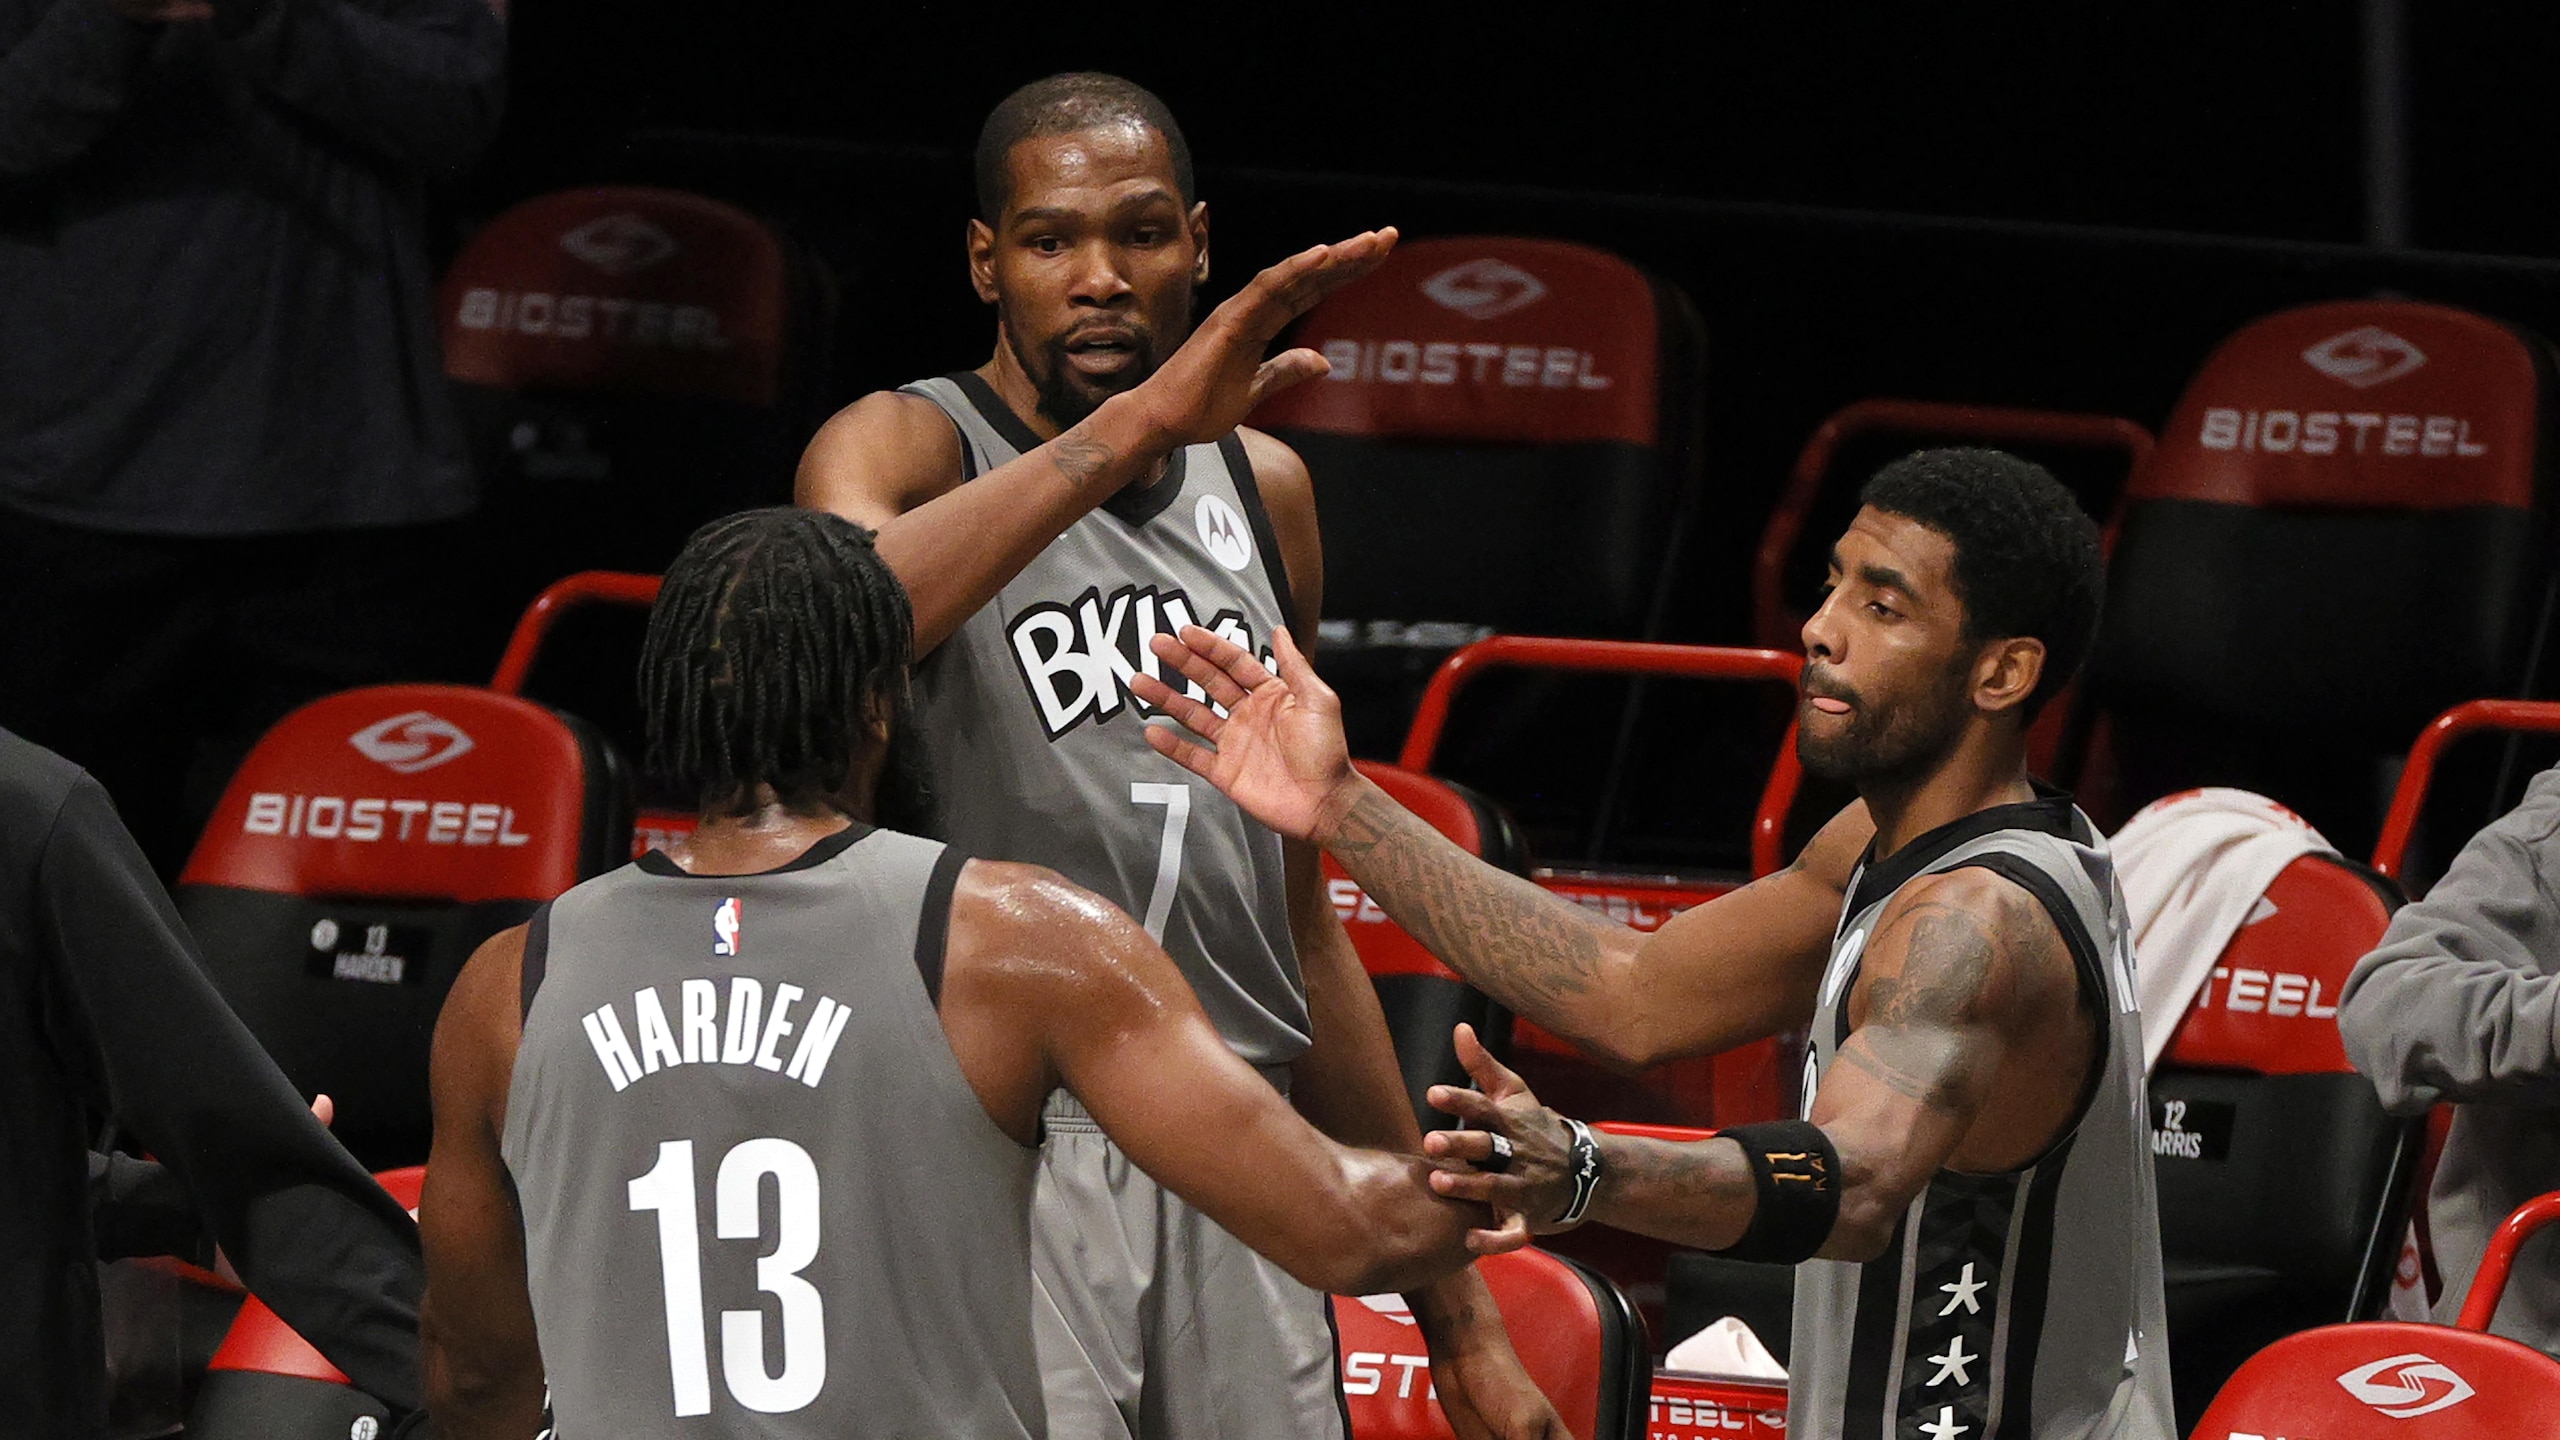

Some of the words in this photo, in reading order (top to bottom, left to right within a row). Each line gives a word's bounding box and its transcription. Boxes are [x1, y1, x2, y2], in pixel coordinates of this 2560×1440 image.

[458, 288, 731, 350] BIOSTEEL
[1322, 340, 1613, 390] BIOSTEEL
[2200, 407, 2488, 457] BIOSTEEL
[243, 792, 531, 847] BIOSTEEL
[1131, 782, 1190, 946] 7
[581, 976, 853, 1093] HARDEN
[2164, 1100, 2187, 1130] 12
[627, 1137, 827, 1418] 13
